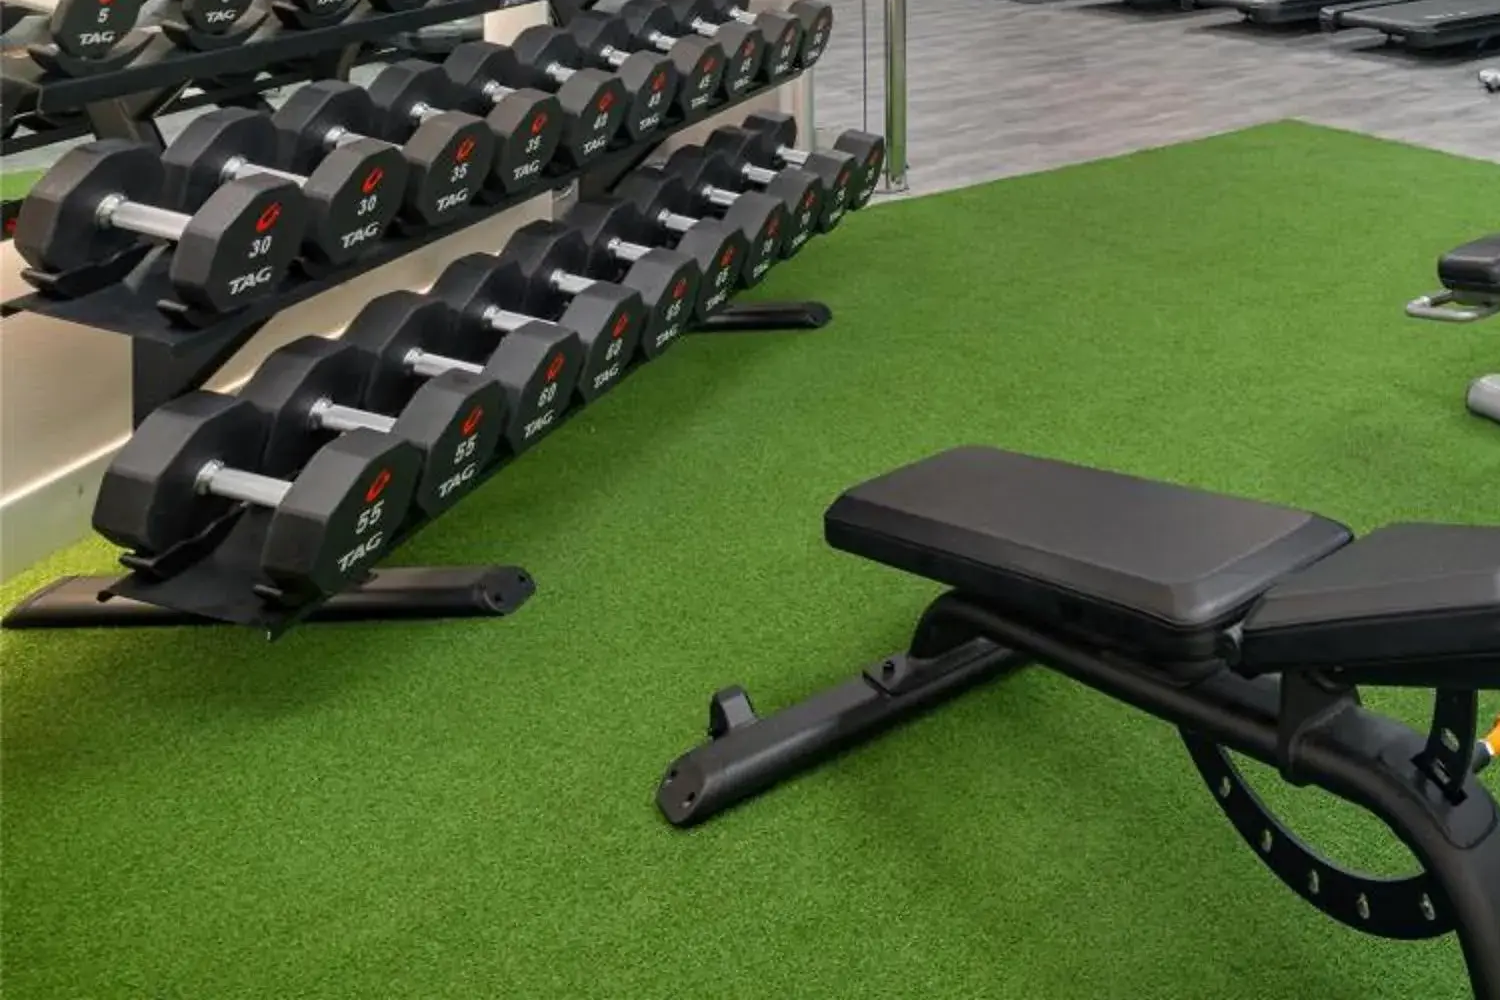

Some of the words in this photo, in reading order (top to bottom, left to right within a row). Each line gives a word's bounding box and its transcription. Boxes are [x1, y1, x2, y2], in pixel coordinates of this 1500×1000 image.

[97, 7, 110, 24] 5
[205, 9, 236, 23] TAG
[79, 31, 115, 46] TAG
[525, 135, 542, 154] 35
[583, 135, 606, 155] TAG
[450, 162, 469, 183] 35
[513, 159, 541, 180] TAG
[357, 194, 377, 216] 30
[436, 187, 469, 212] TAG
[248, 235, 273, 259] 30
[341, 221, 379, 249] TAG
[228, 266, 272, 295] TAG
[593, 362, 619, 389] TAG
[537, 382, 558, 408] 60
[523, 409, 555, 439] TAG
[453, 433, 478, 465] 55
[438, 461, 476, 498] TAG
[355, 500, 385, 535] 55
[337, 530, 384, 573] TAG
